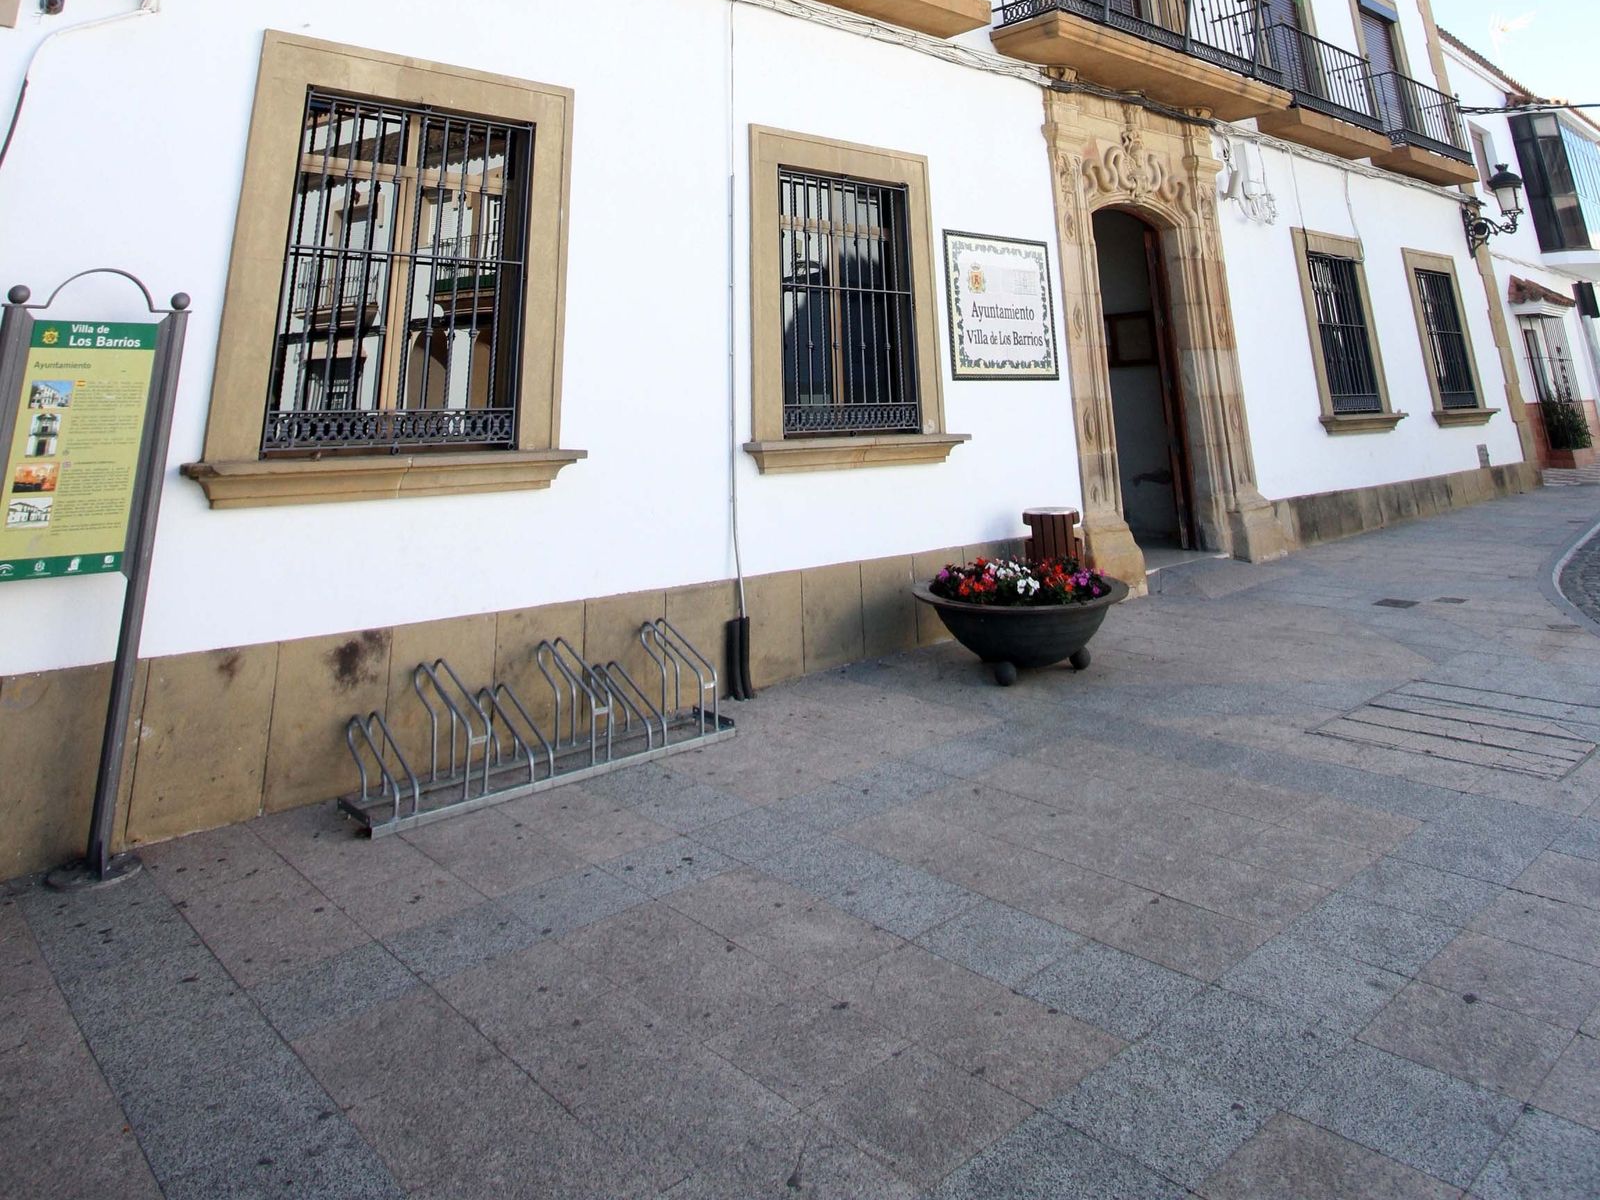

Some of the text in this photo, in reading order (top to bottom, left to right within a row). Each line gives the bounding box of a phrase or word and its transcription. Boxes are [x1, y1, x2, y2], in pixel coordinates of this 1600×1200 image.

[971, 300, 1035, 323] Ayuntamiento
[71, 324, 110, 334] Villa de
[69, 335, 141, 348] Los Barrios
[966, 329, 1044, 347] Villa de Los Barrios
[34, 361, 92, 370] Ayuntamiento
